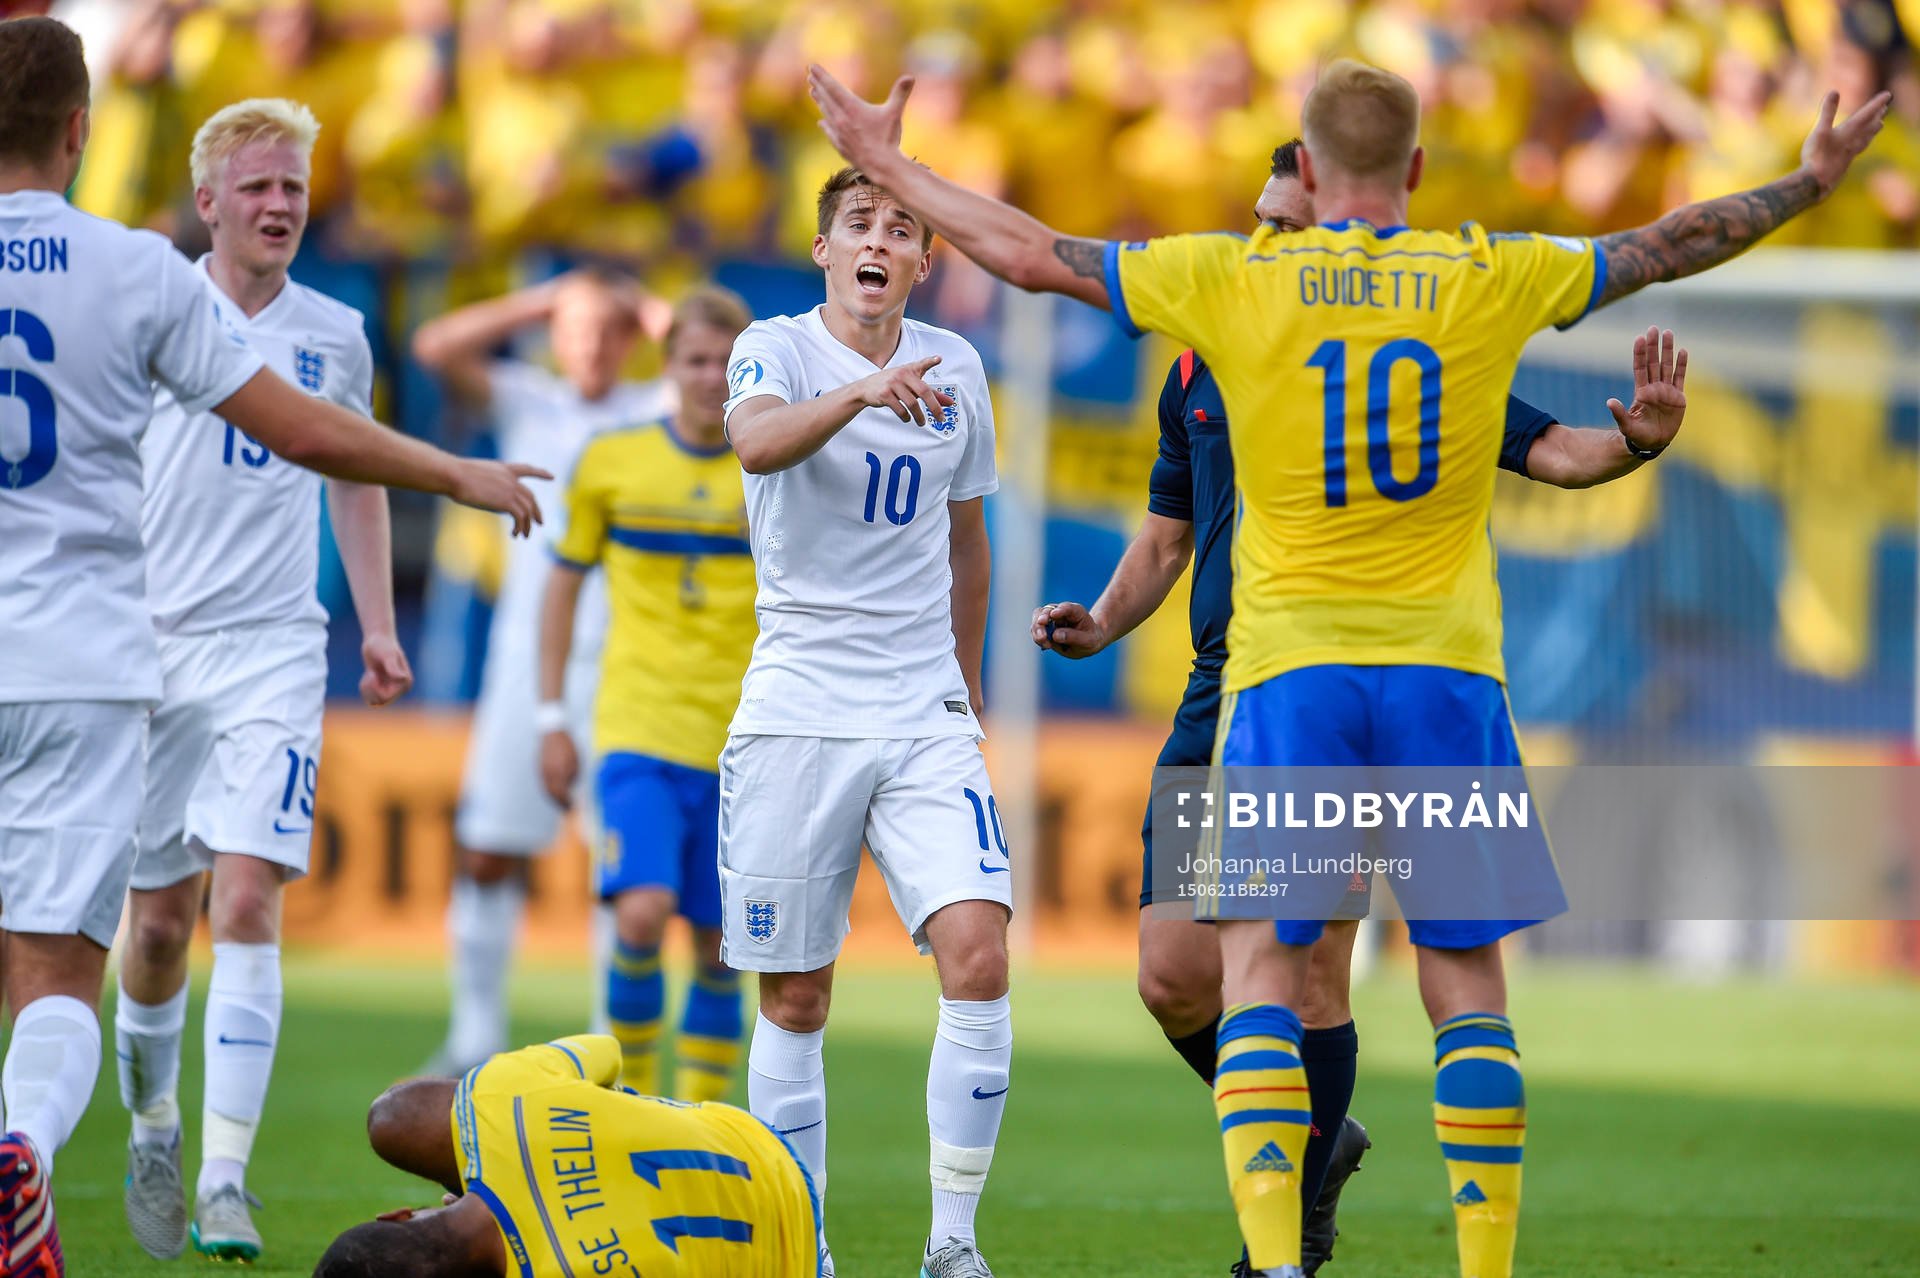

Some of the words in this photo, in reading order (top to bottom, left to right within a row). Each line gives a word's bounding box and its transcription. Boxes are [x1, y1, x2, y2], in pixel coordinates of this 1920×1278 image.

[1300, 265, 1438, 311] GUIDETTI
[1304, 337, 1443, 508] 10
[864, 451, 922, 526] 10
[281, 748, 317, 818] 19
[963, 787, 1009, 860] 10
[548, 1107, 605, 1221] THELIN
[629, 1149, 754, 1256] 11
